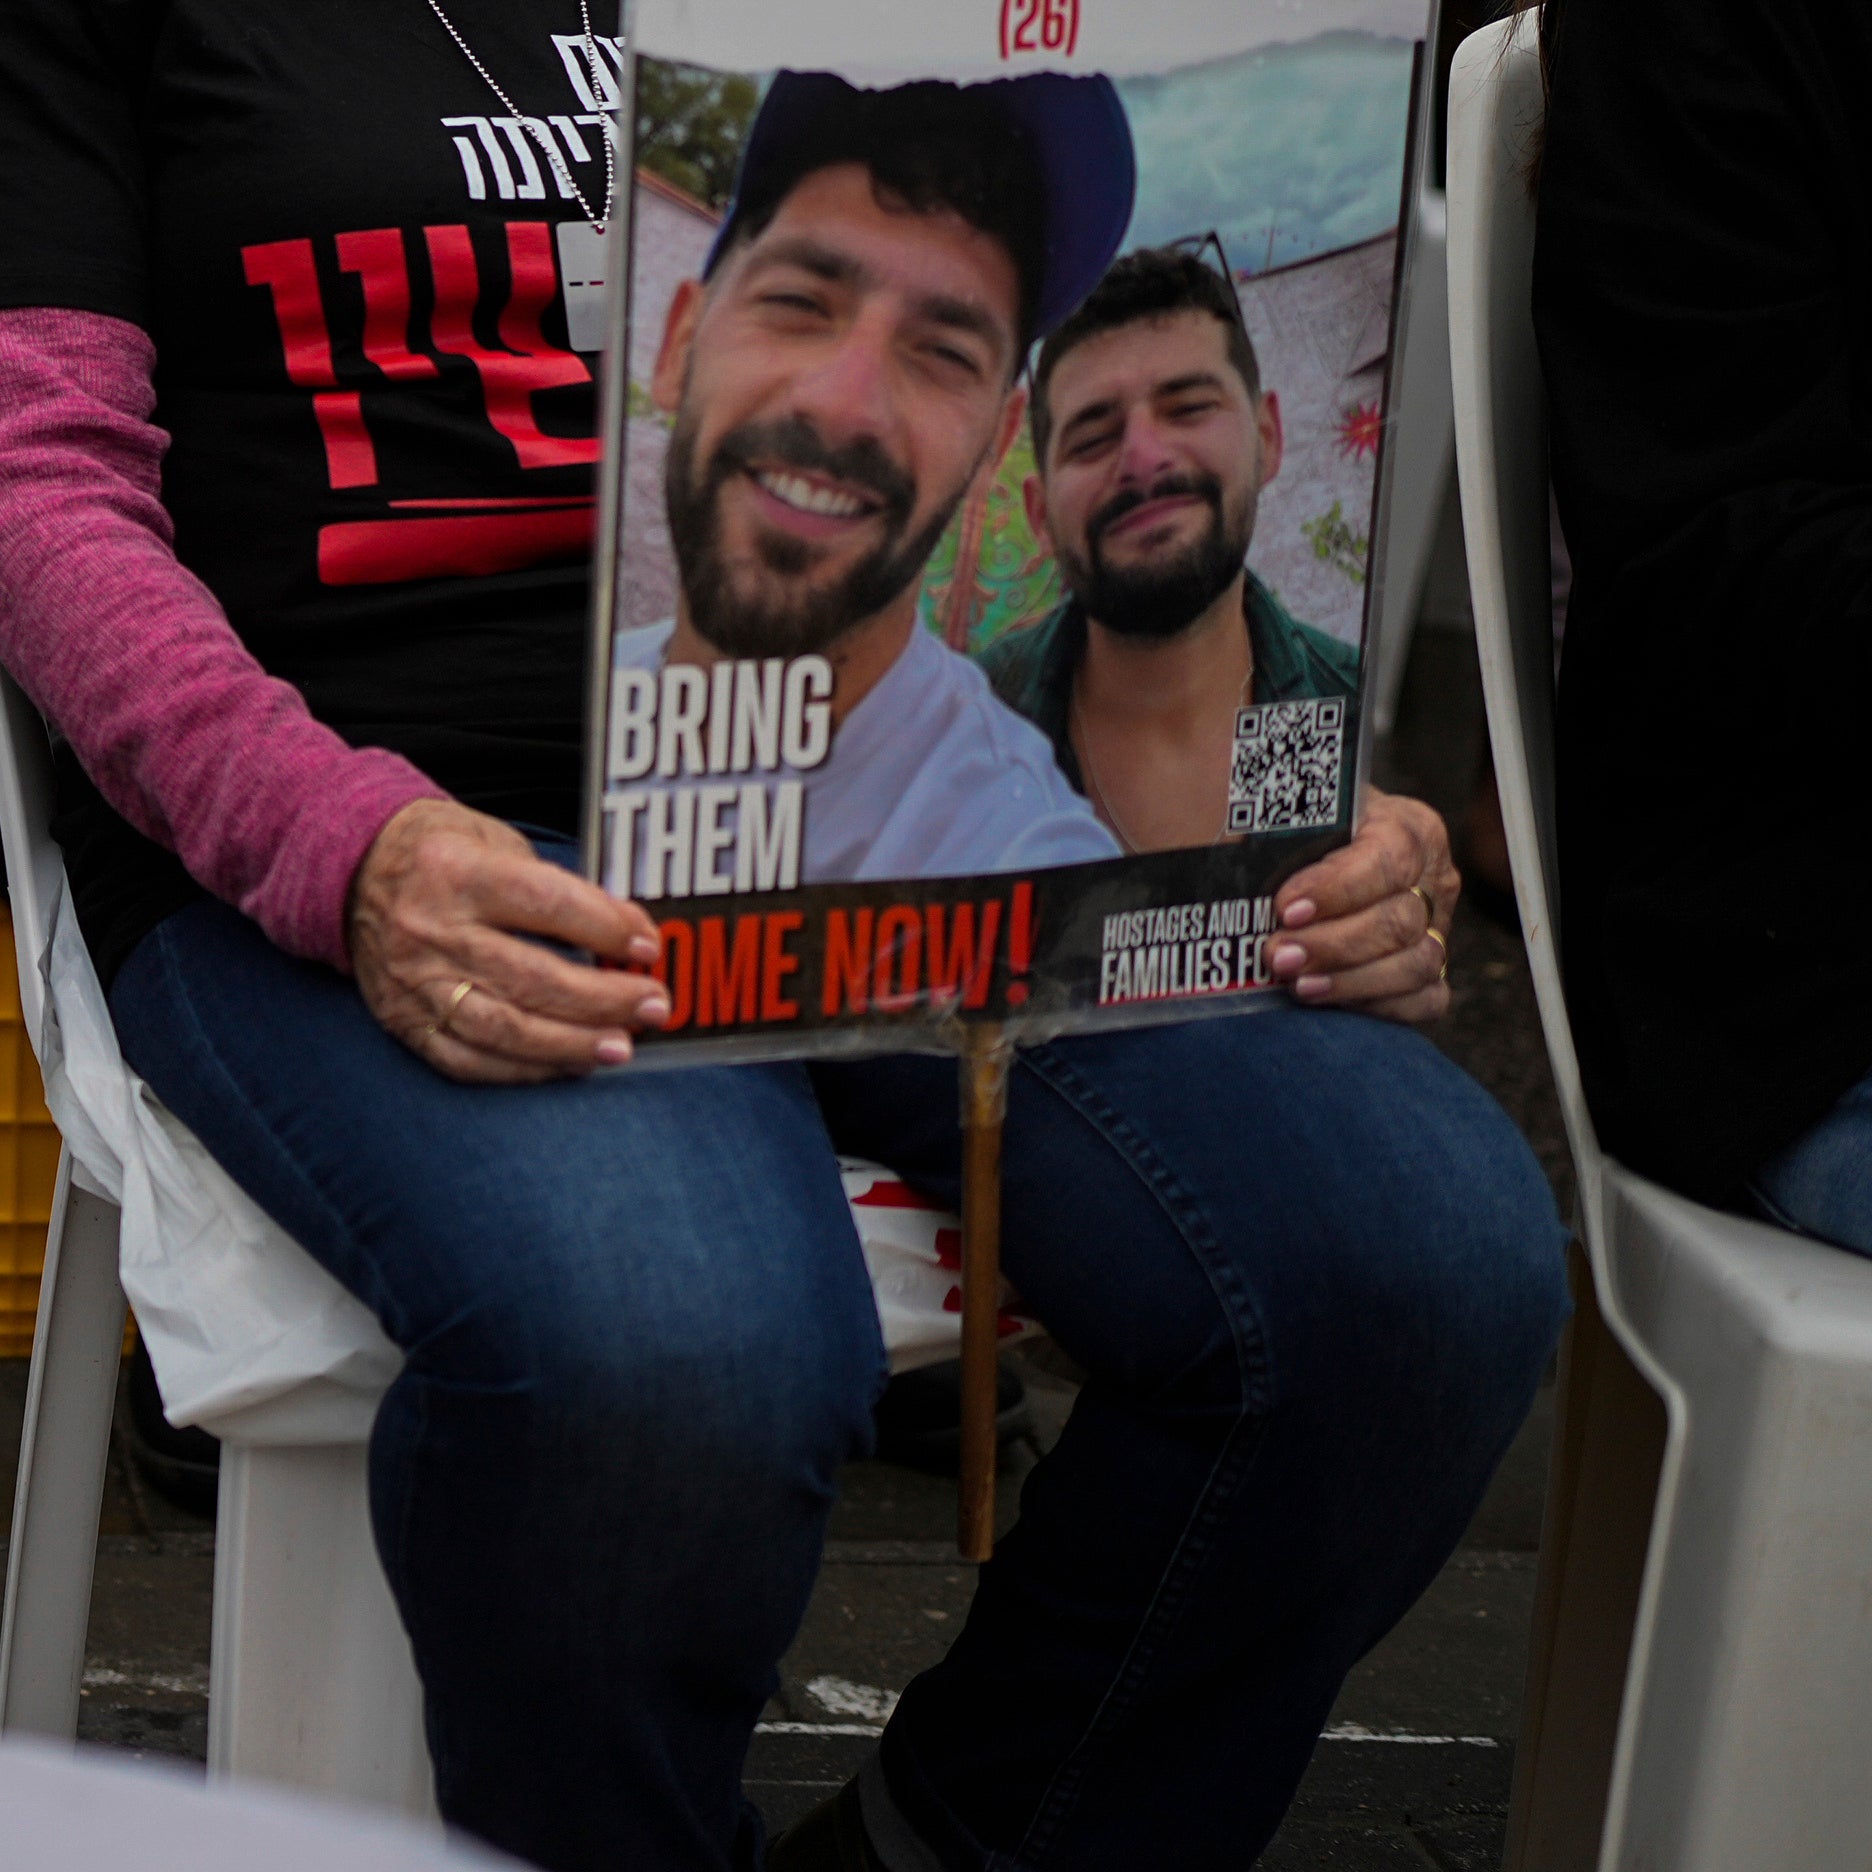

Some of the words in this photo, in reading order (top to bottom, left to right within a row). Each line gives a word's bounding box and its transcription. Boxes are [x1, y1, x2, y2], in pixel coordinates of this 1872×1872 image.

[609, 654, 833, 780] BRING
[604, 780, 803, 902] THEM
[608, 910, 804, 1031] OME
[821, 880, 1033, 1016] NOW!
[1099, 937, 1233, 1004] FAMILIES
[1102, 901, 1206, 951] HOSTAGES
[1206, 898, 1251, 939] AND
